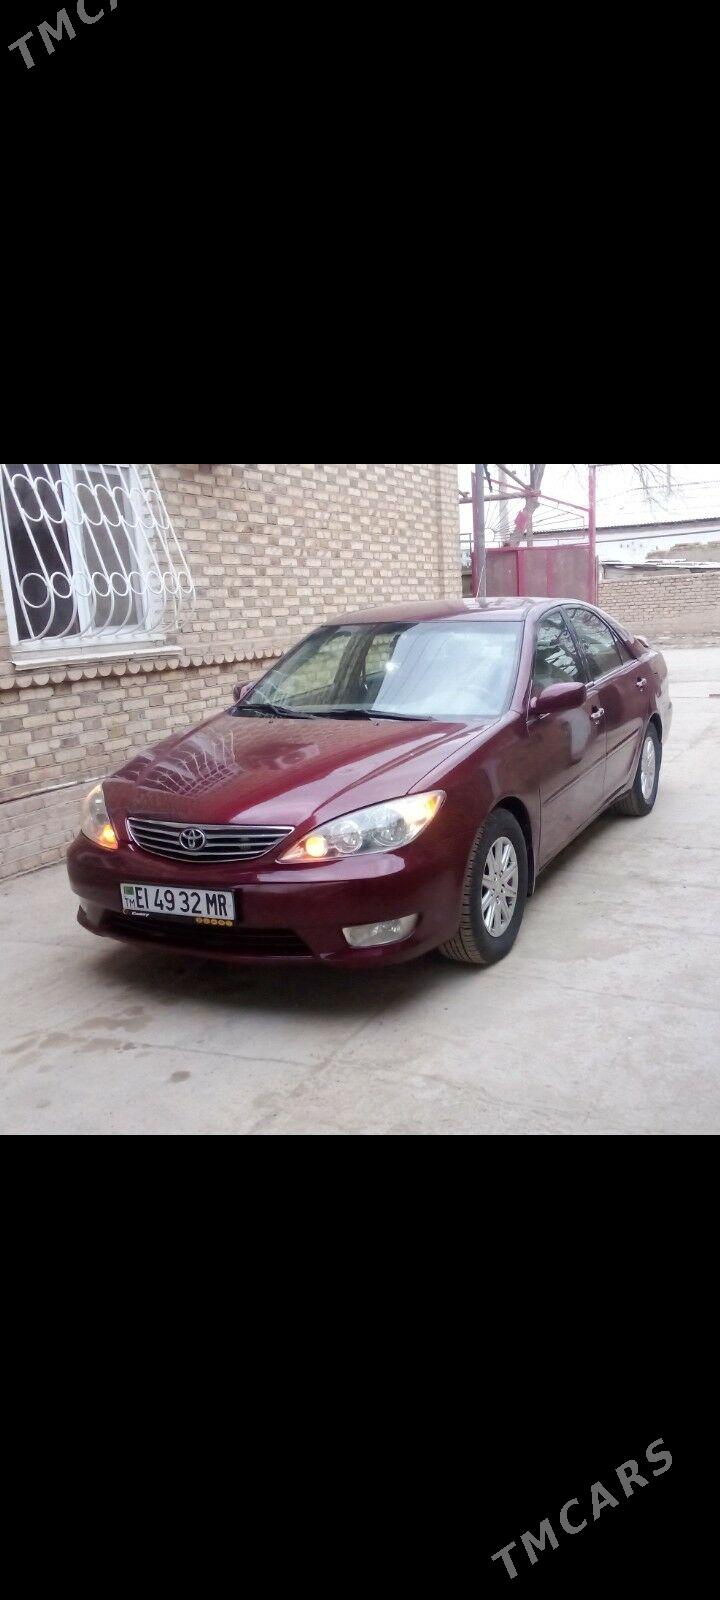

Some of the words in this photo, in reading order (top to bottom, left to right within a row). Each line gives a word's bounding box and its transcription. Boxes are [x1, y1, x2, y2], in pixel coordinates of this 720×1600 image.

[125, 897, 135, 908] TM
[154, 889, 175, 911] 49
[179, 891, 202, 914] 32
[205, 893, 228, 916] MR
